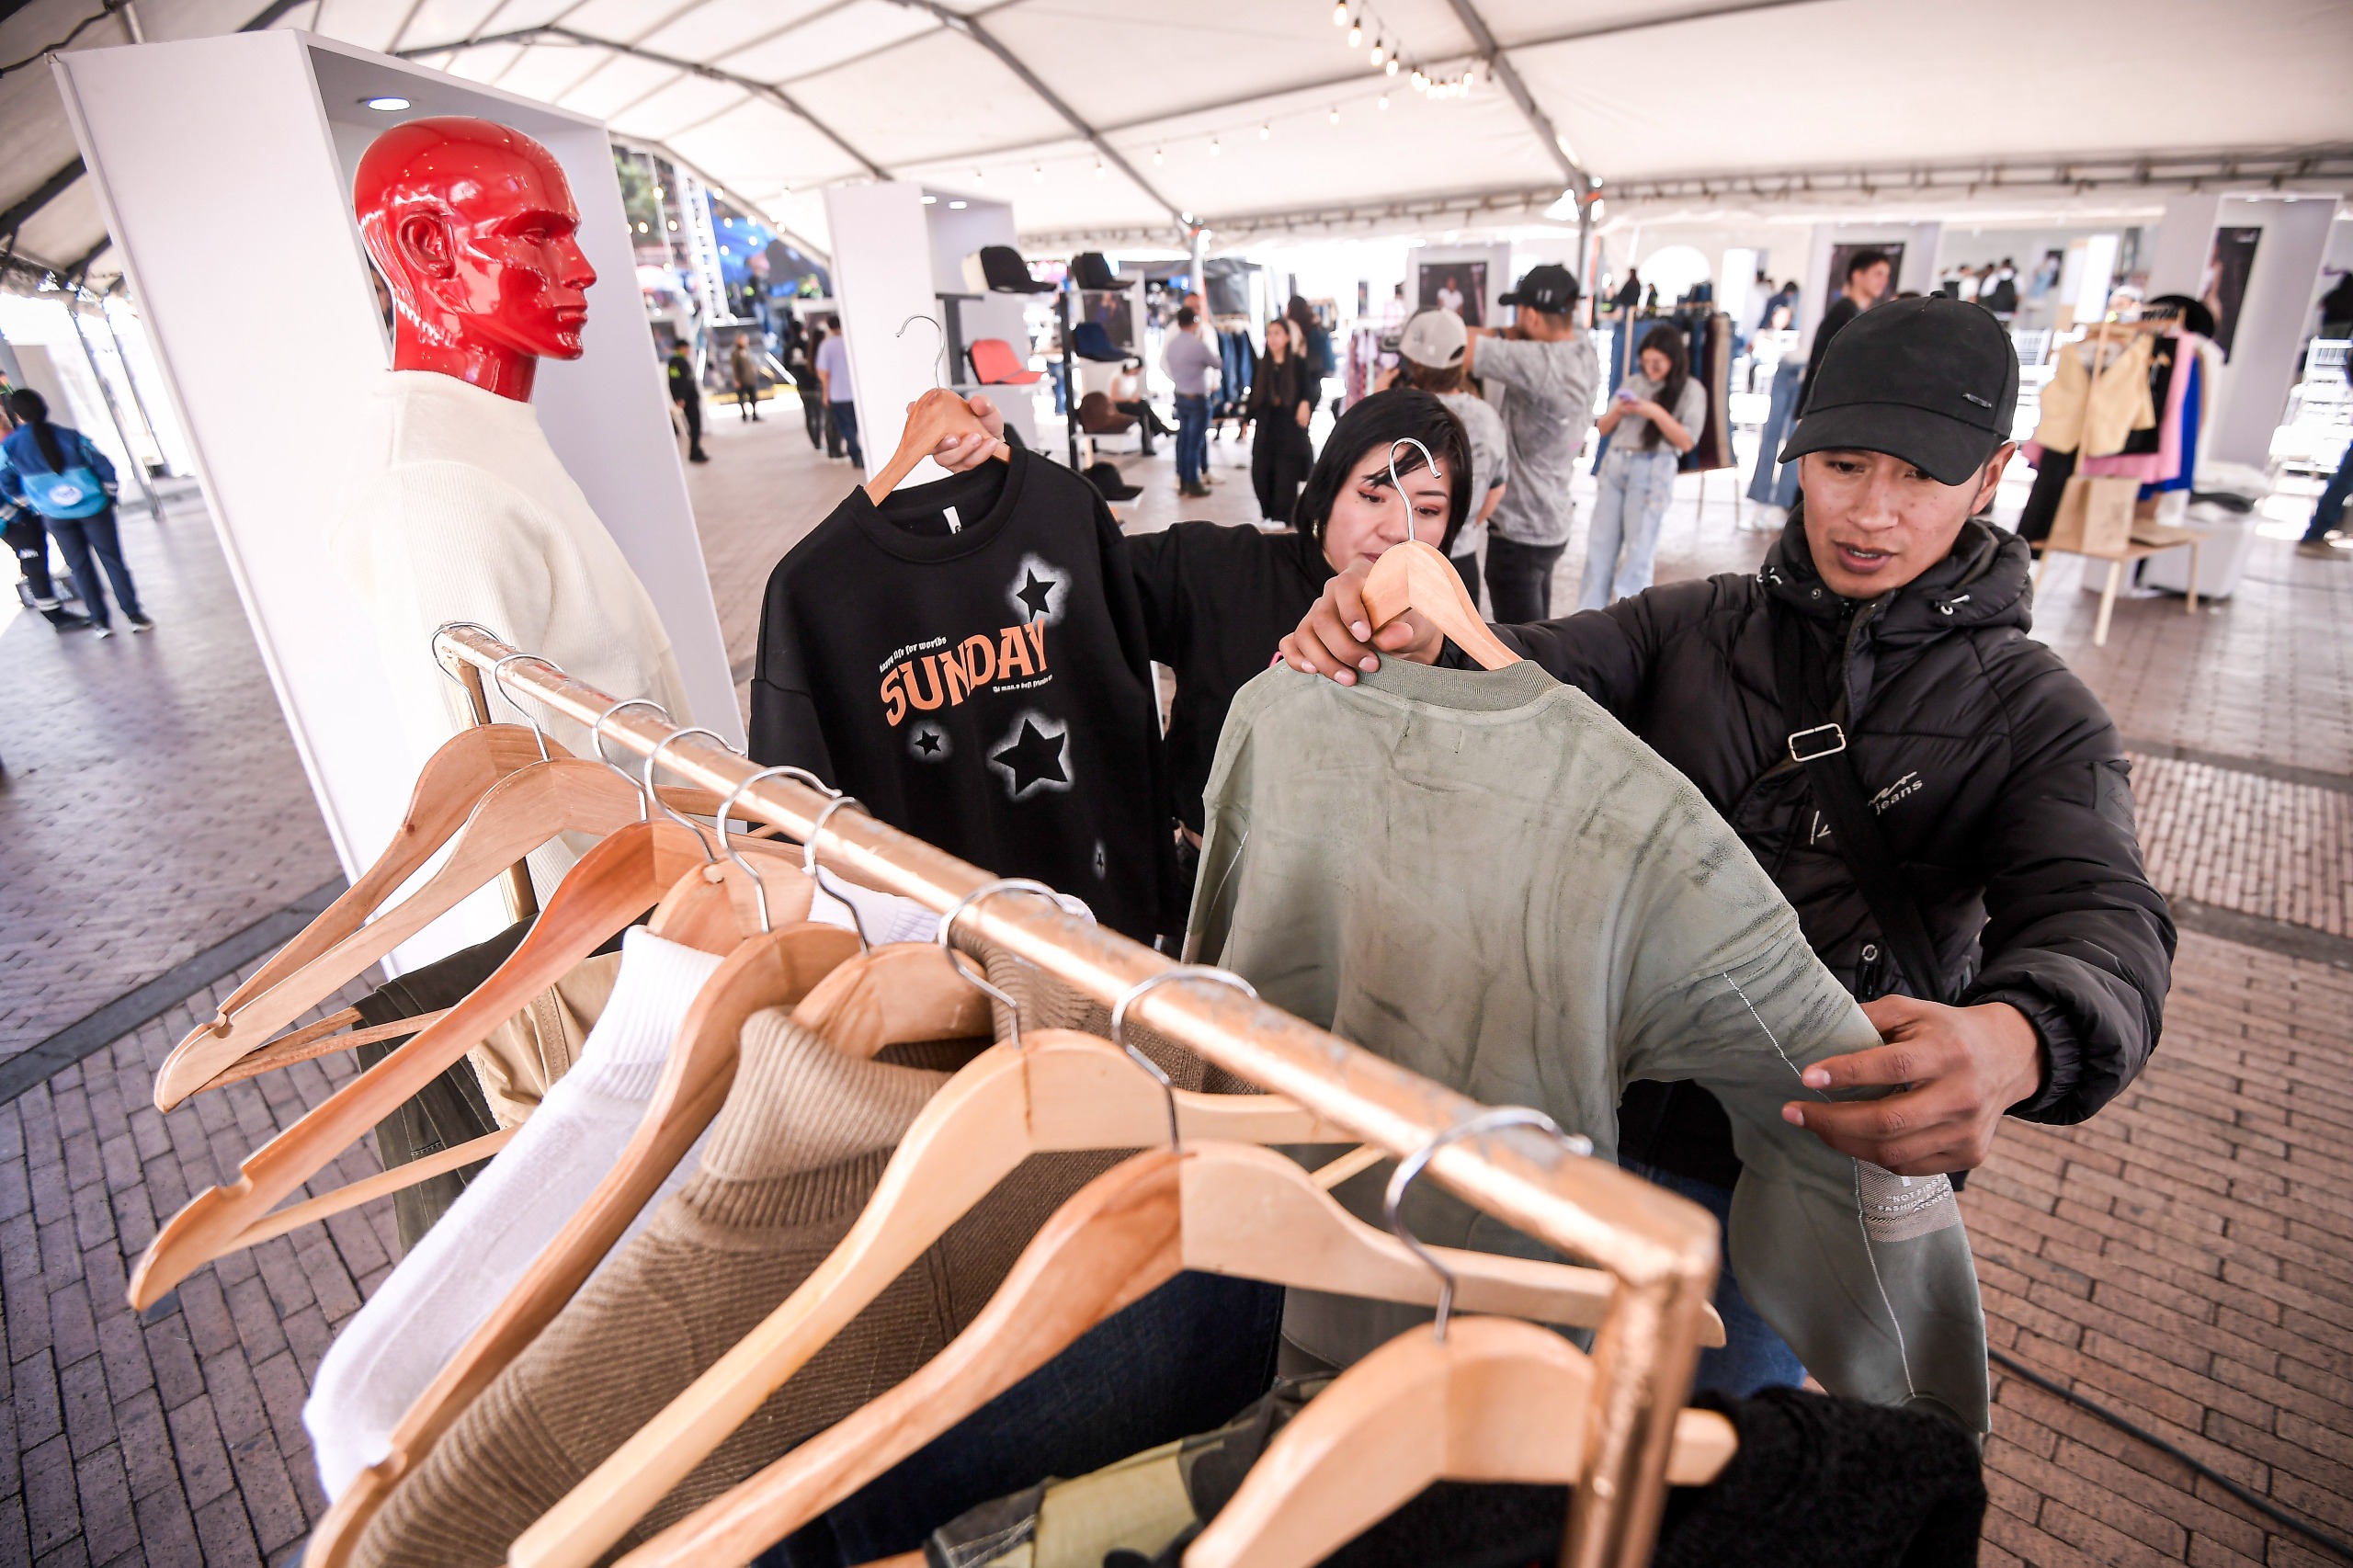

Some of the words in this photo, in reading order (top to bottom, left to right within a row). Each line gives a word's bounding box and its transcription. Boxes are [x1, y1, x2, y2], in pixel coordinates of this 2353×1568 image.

[893, 648, 904, 660] life
[904, 644, 918, 655] for
[880, 618, 1048, 727] SUNDAY
[1875, 779, 1923, 815] jeans
[1878, 1198, 1925, 1212] FASHION
